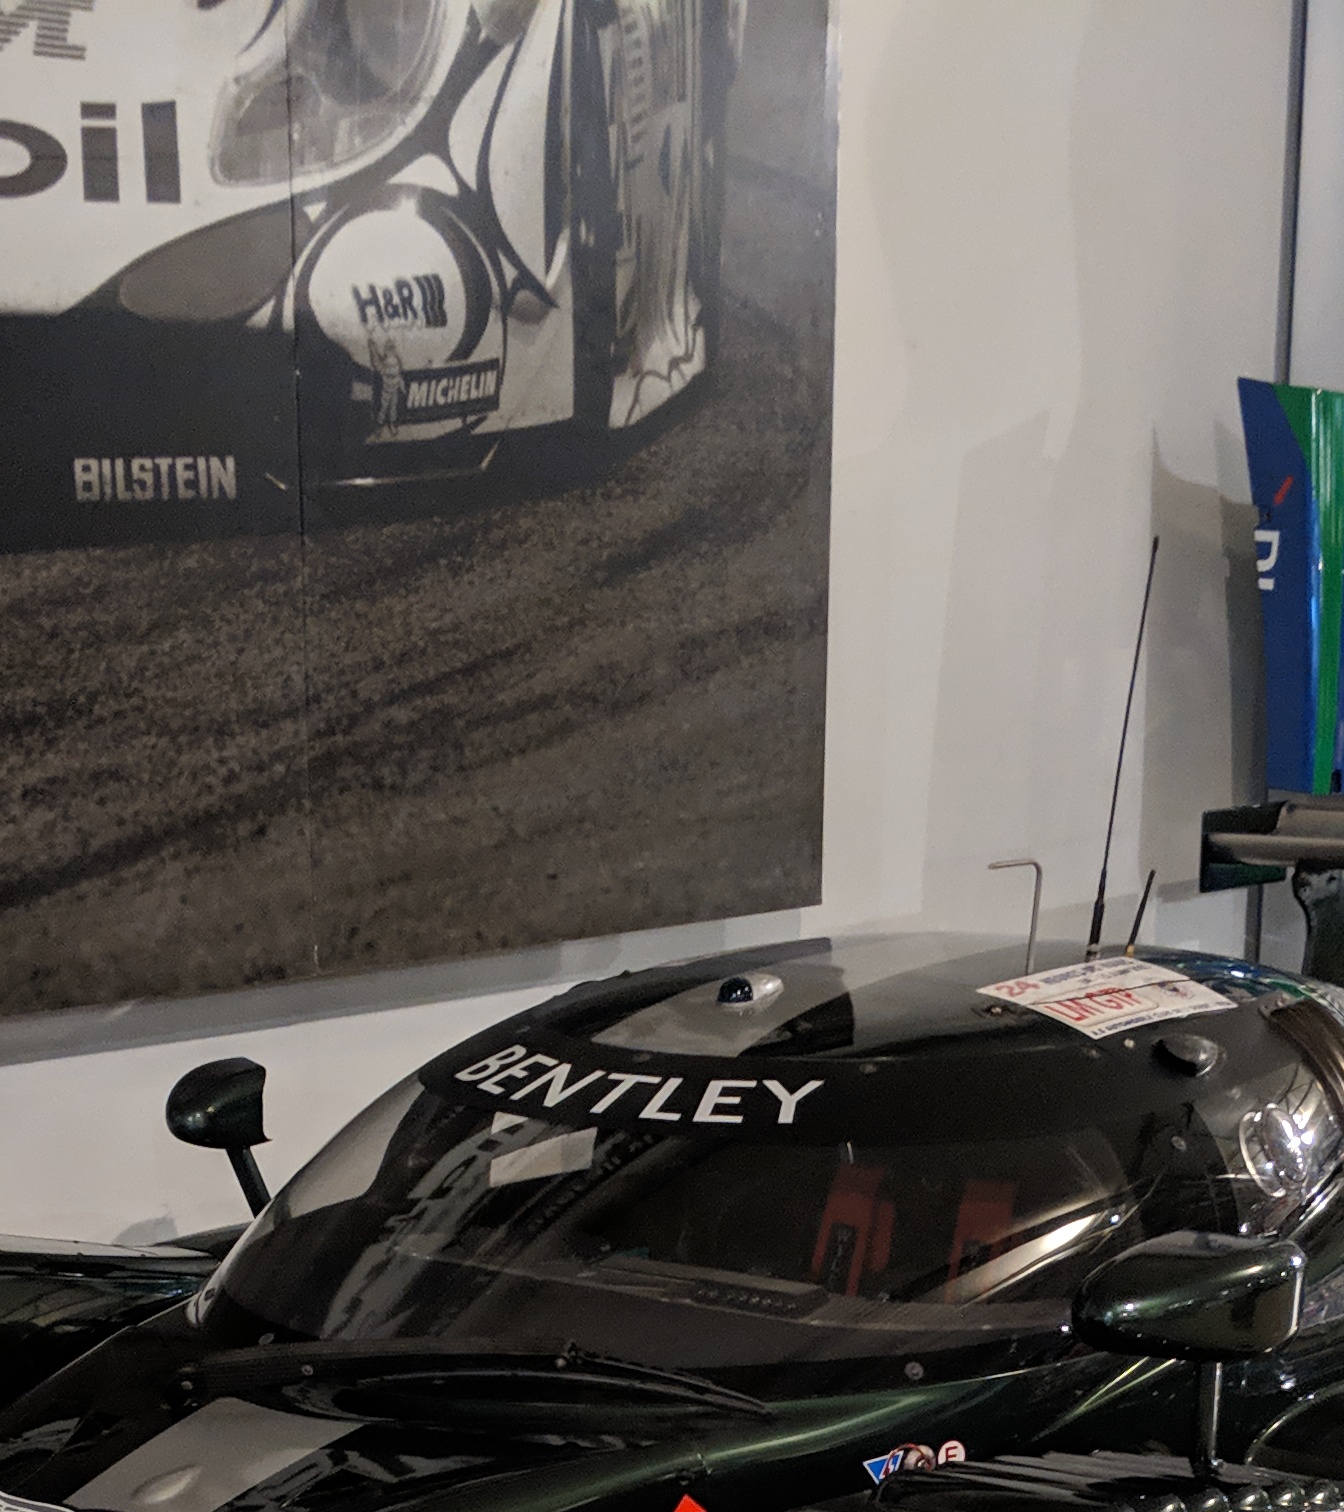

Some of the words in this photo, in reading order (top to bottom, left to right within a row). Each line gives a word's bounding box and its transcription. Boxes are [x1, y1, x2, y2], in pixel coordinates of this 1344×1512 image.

[352, 279, 419, 324] H&R
[406, 370, 498, 409] MICHELIN
[74, 455, 237, 501] BILSTEIN
[994, 979, 1041, 998] 24
[454, 1043, 825, 1125] BENTLEY
